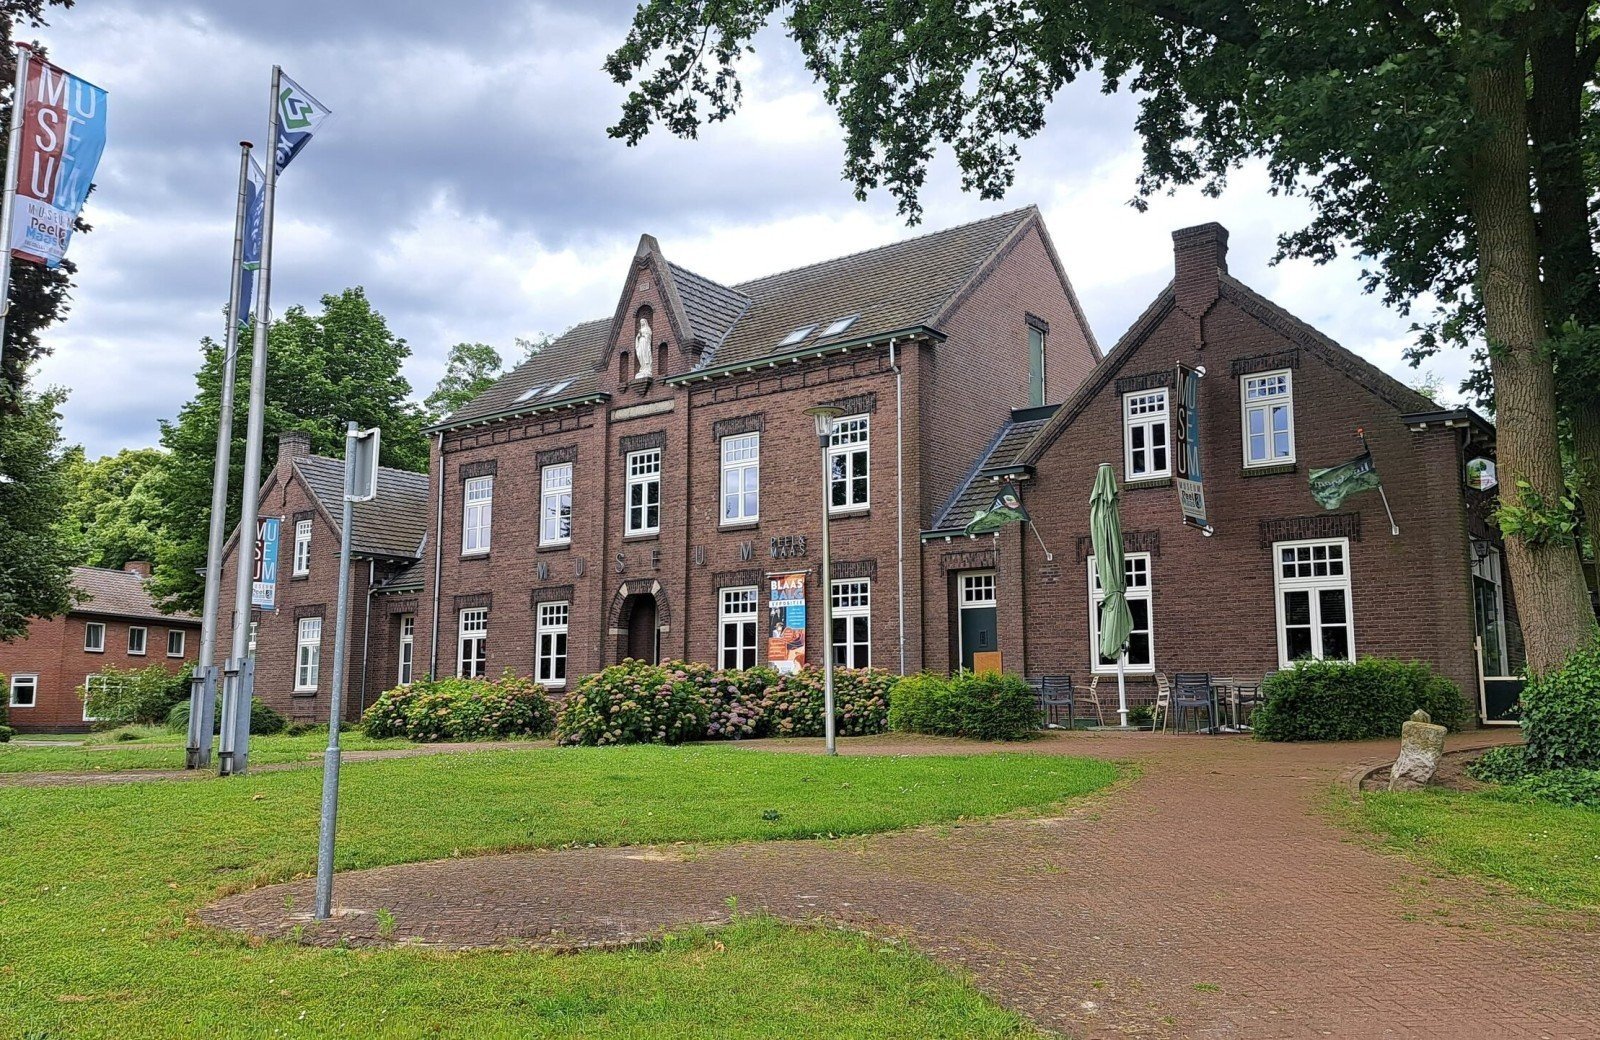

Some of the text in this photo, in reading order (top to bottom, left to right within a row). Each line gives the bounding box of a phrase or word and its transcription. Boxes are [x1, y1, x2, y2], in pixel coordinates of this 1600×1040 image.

[31, 217, 58, 238] Peel
[26, 226, 58, 247] Maas
[770, 545, 806, 558] MAAS
[771, 579, 803, 590] BLAAS
[771, 588, 804, 600] BALG
